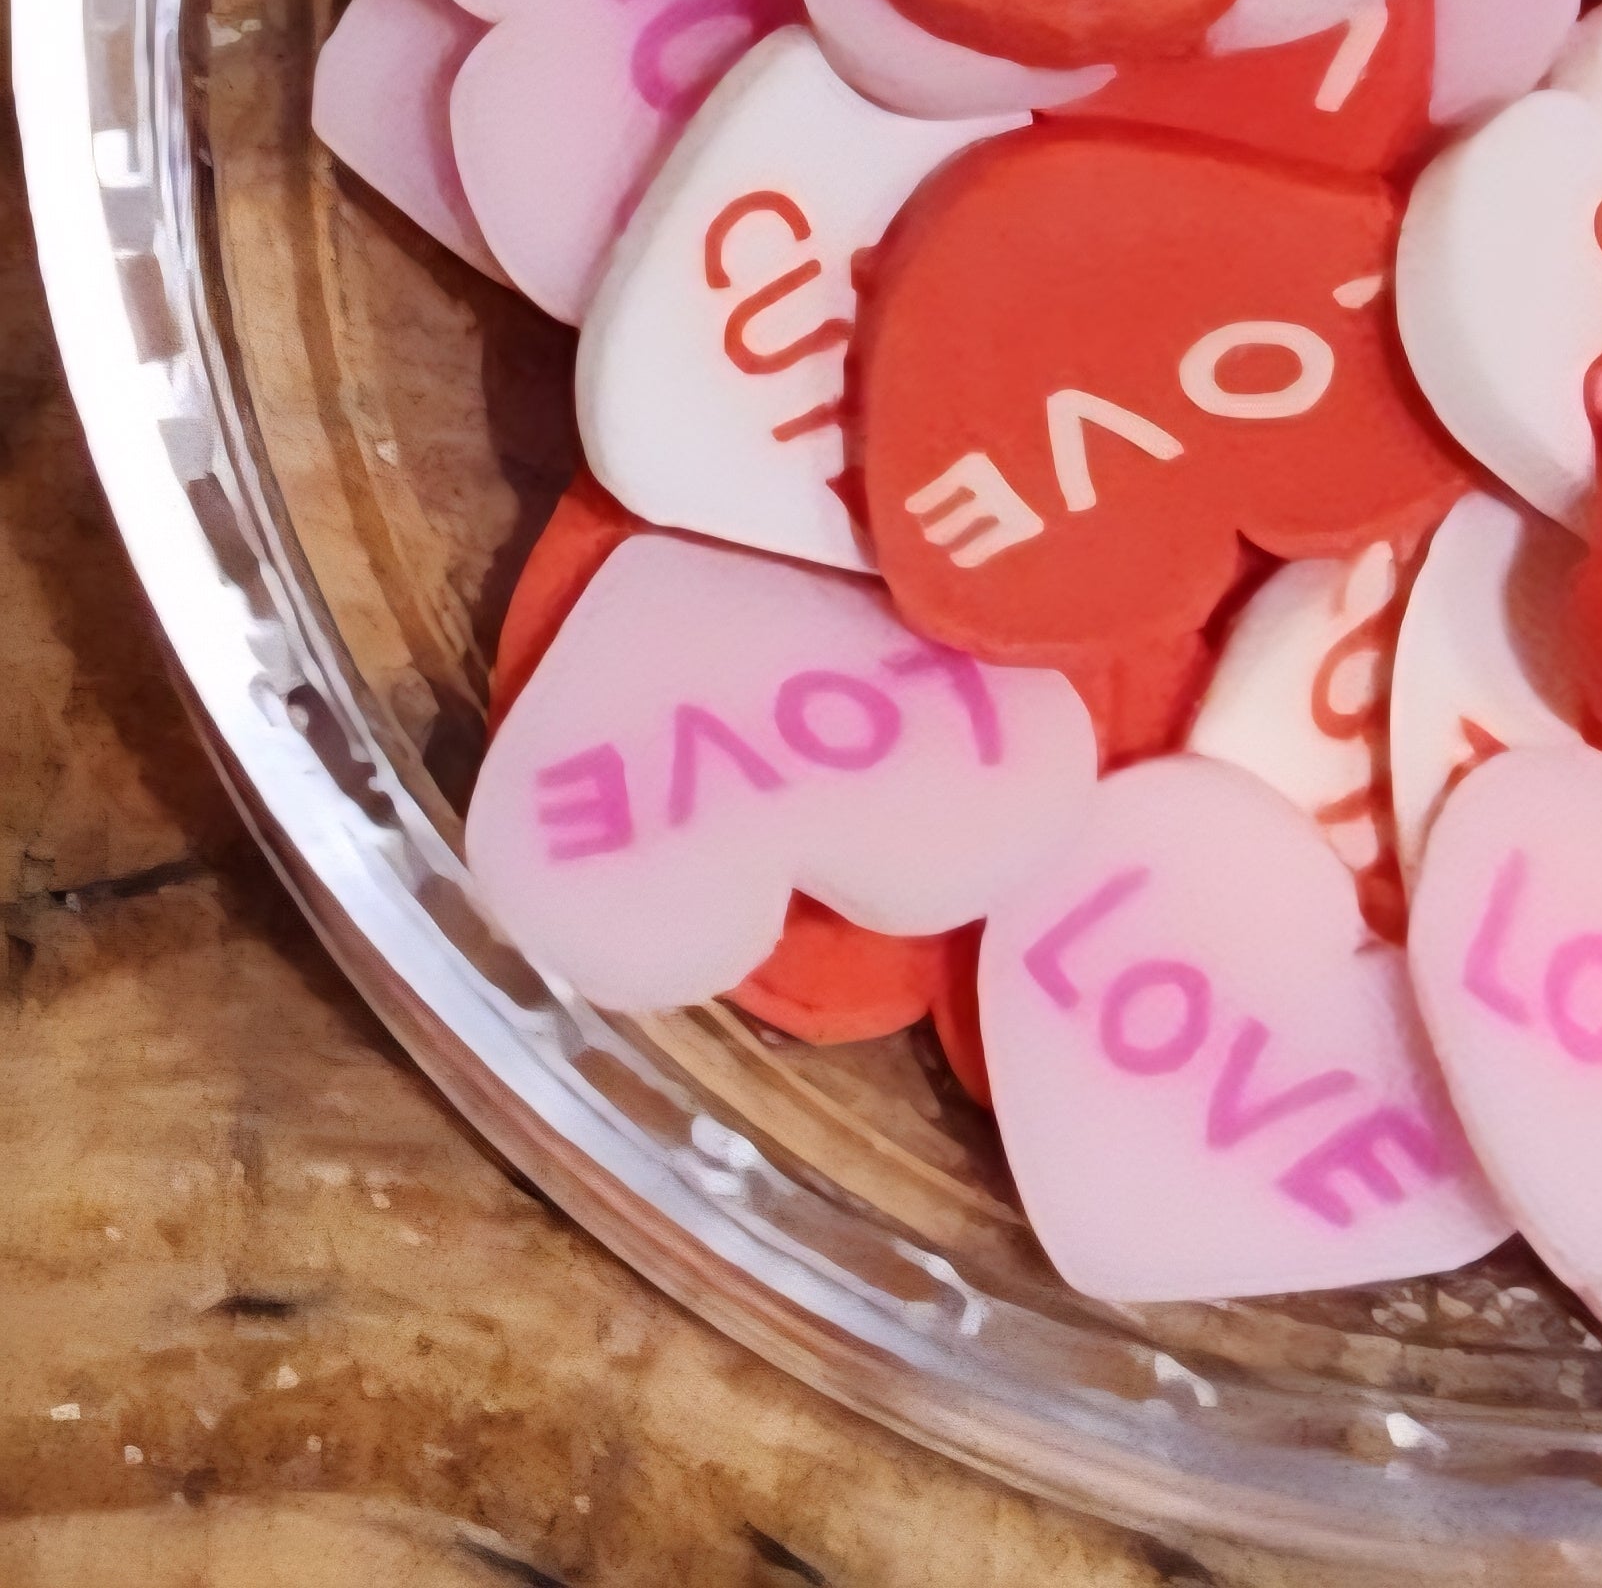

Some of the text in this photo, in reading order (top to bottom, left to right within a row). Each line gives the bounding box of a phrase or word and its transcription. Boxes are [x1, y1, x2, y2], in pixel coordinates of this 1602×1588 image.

[904, 274, 1383, 570] OVE
[534, 650, 1001, 863] LOVE
[1023, 865, 1450, 1230] LOVE
